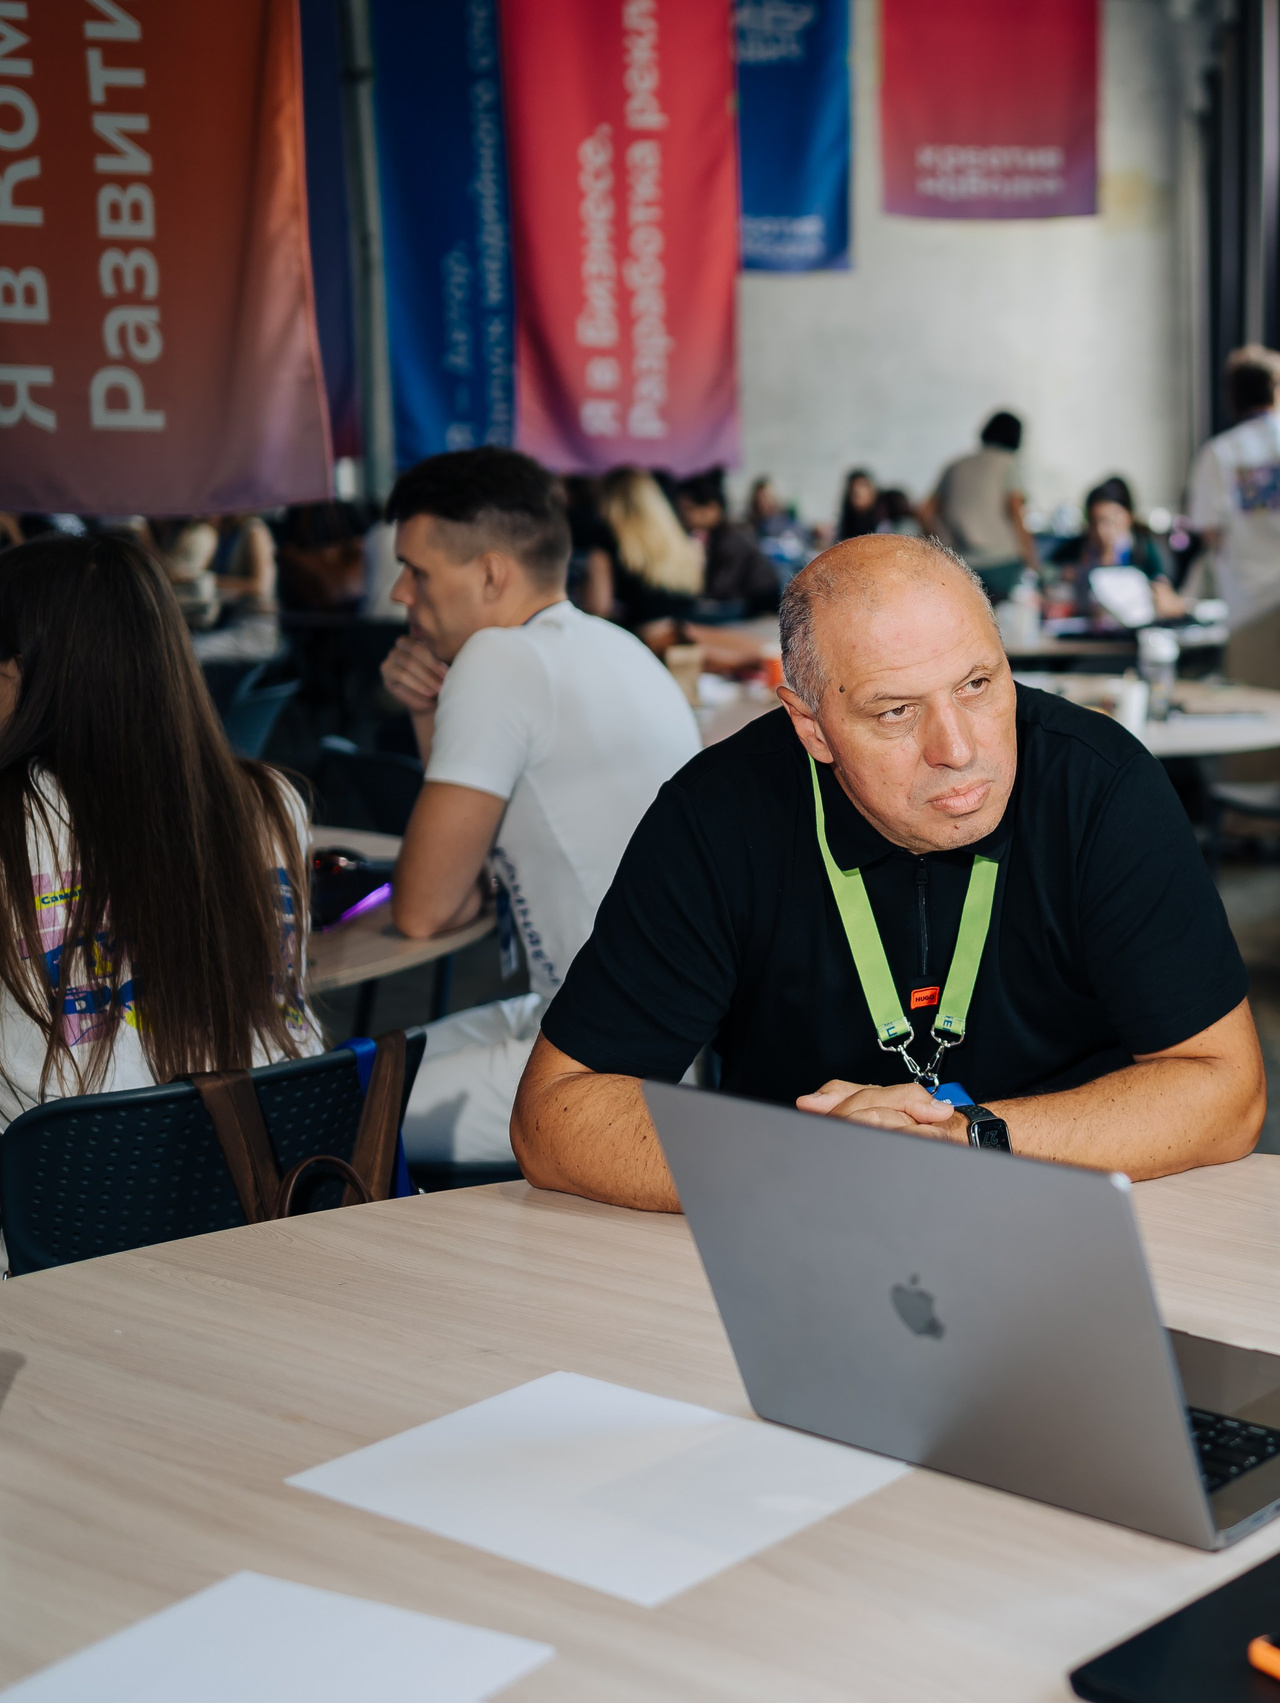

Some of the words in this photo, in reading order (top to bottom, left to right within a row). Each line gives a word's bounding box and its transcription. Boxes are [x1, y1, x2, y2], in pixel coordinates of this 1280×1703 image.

[623, 140, 673, 438] Разработка
[579, 400, 620, 437] Я
[915, 994, 935, 1003] HUGO
